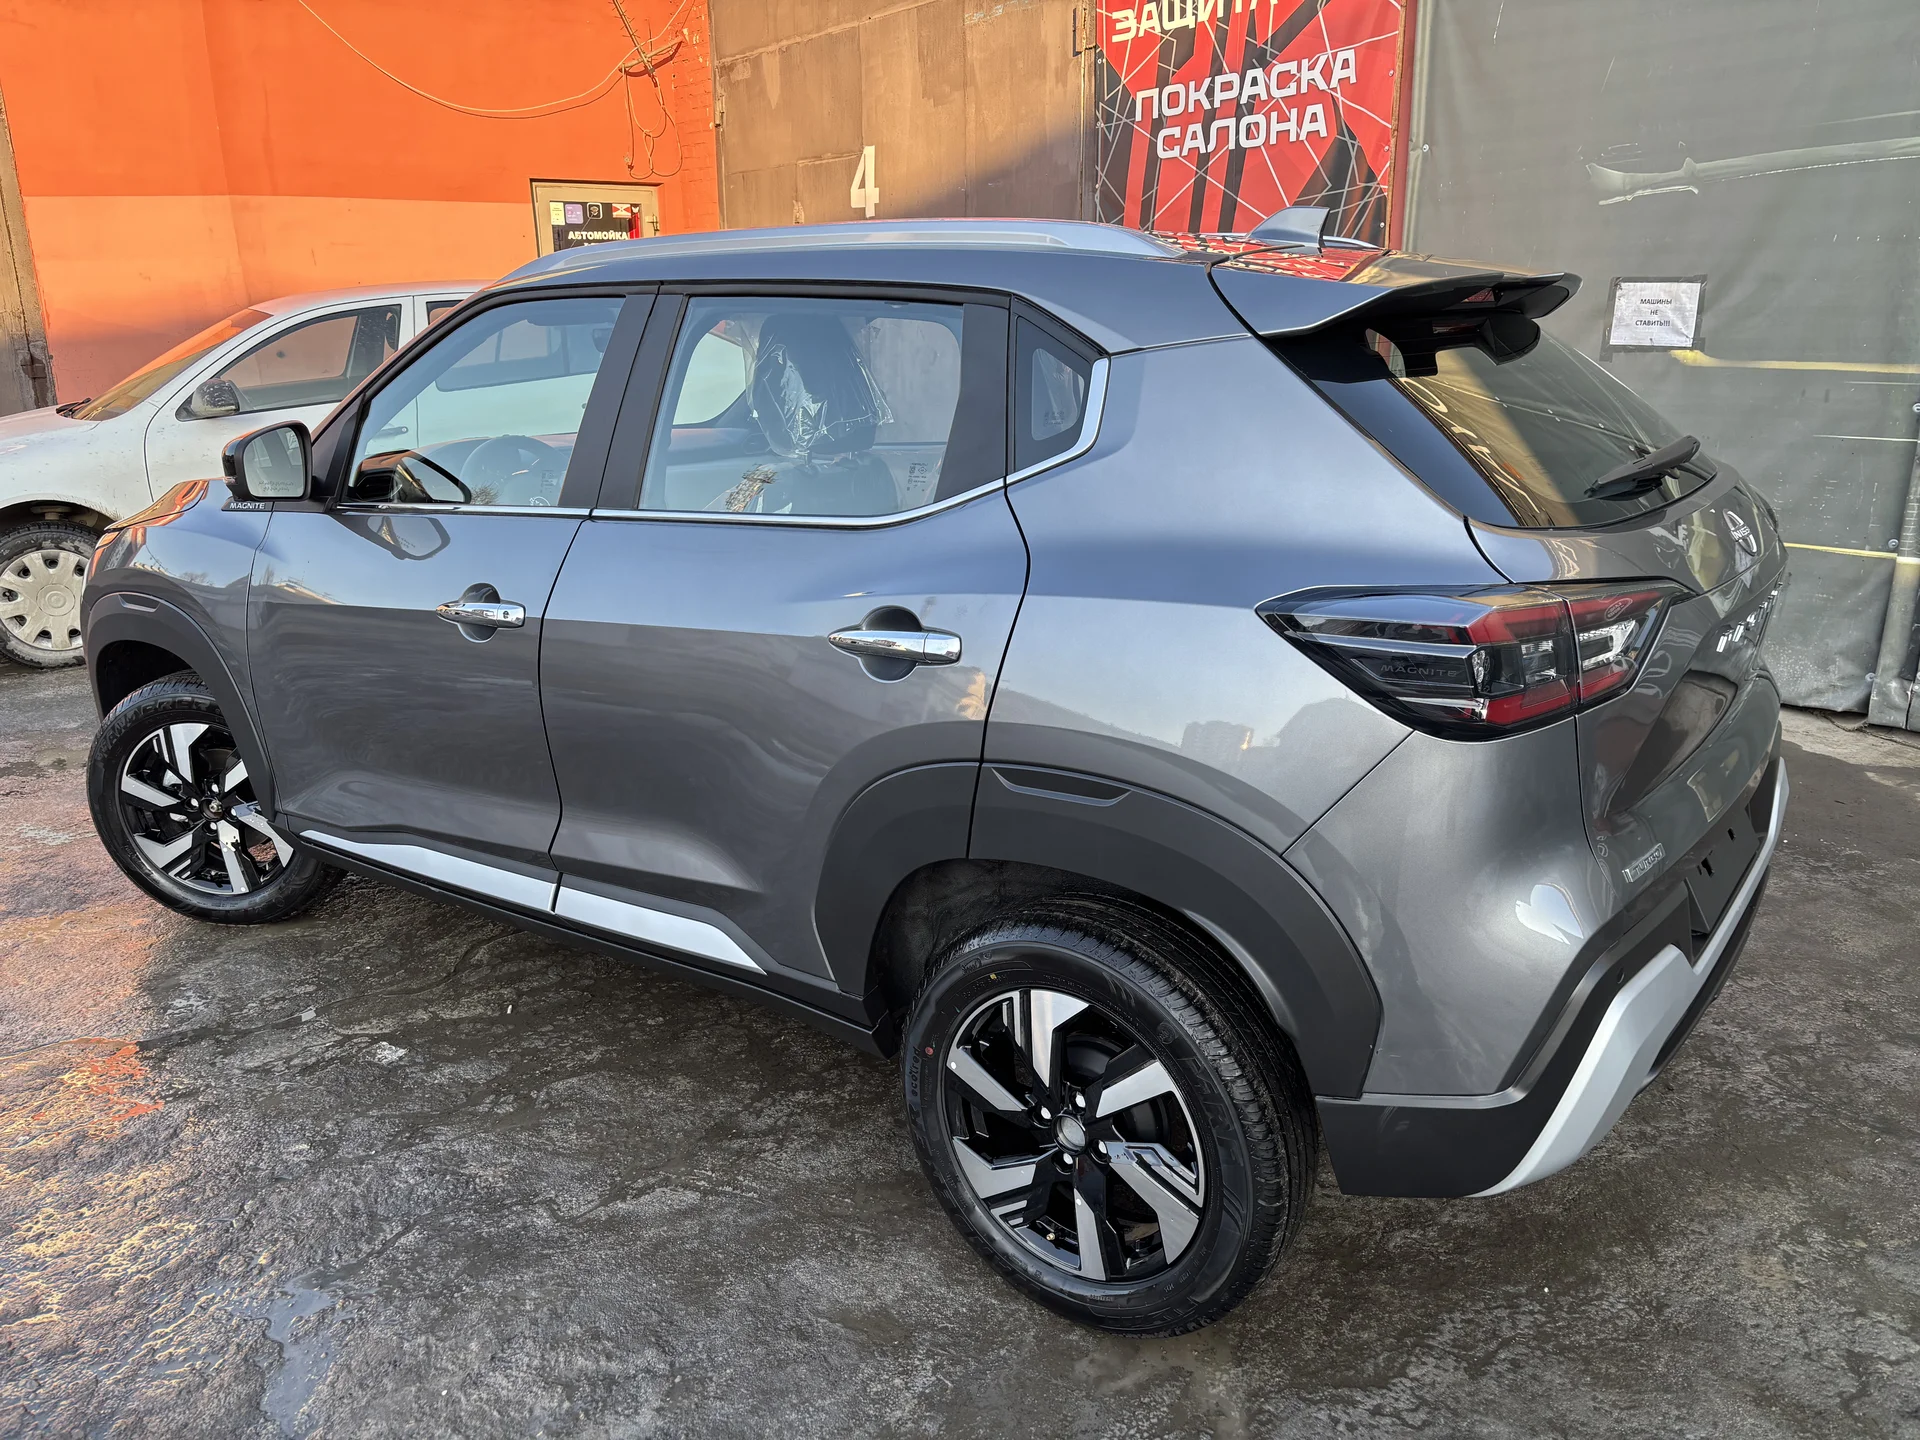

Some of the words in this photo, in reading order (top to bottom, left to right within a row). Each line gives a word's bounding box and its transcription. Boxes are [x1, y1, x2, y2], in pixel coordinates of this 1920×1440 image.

[1112, 0, 1278, 43] ЗАЩИ
[1135, 49, 1357, 122] ПОКРАСКА
[1157, 103, 1328, 159] САЛОНА
[850, 145, 880, 218] 4
[568, 230, 628, 240] АВТОМОЙКА
[1635, 319, 1671, 327] СТАВИТЬ!!!
[1380, 664, 1457, 678] MAGNITE
